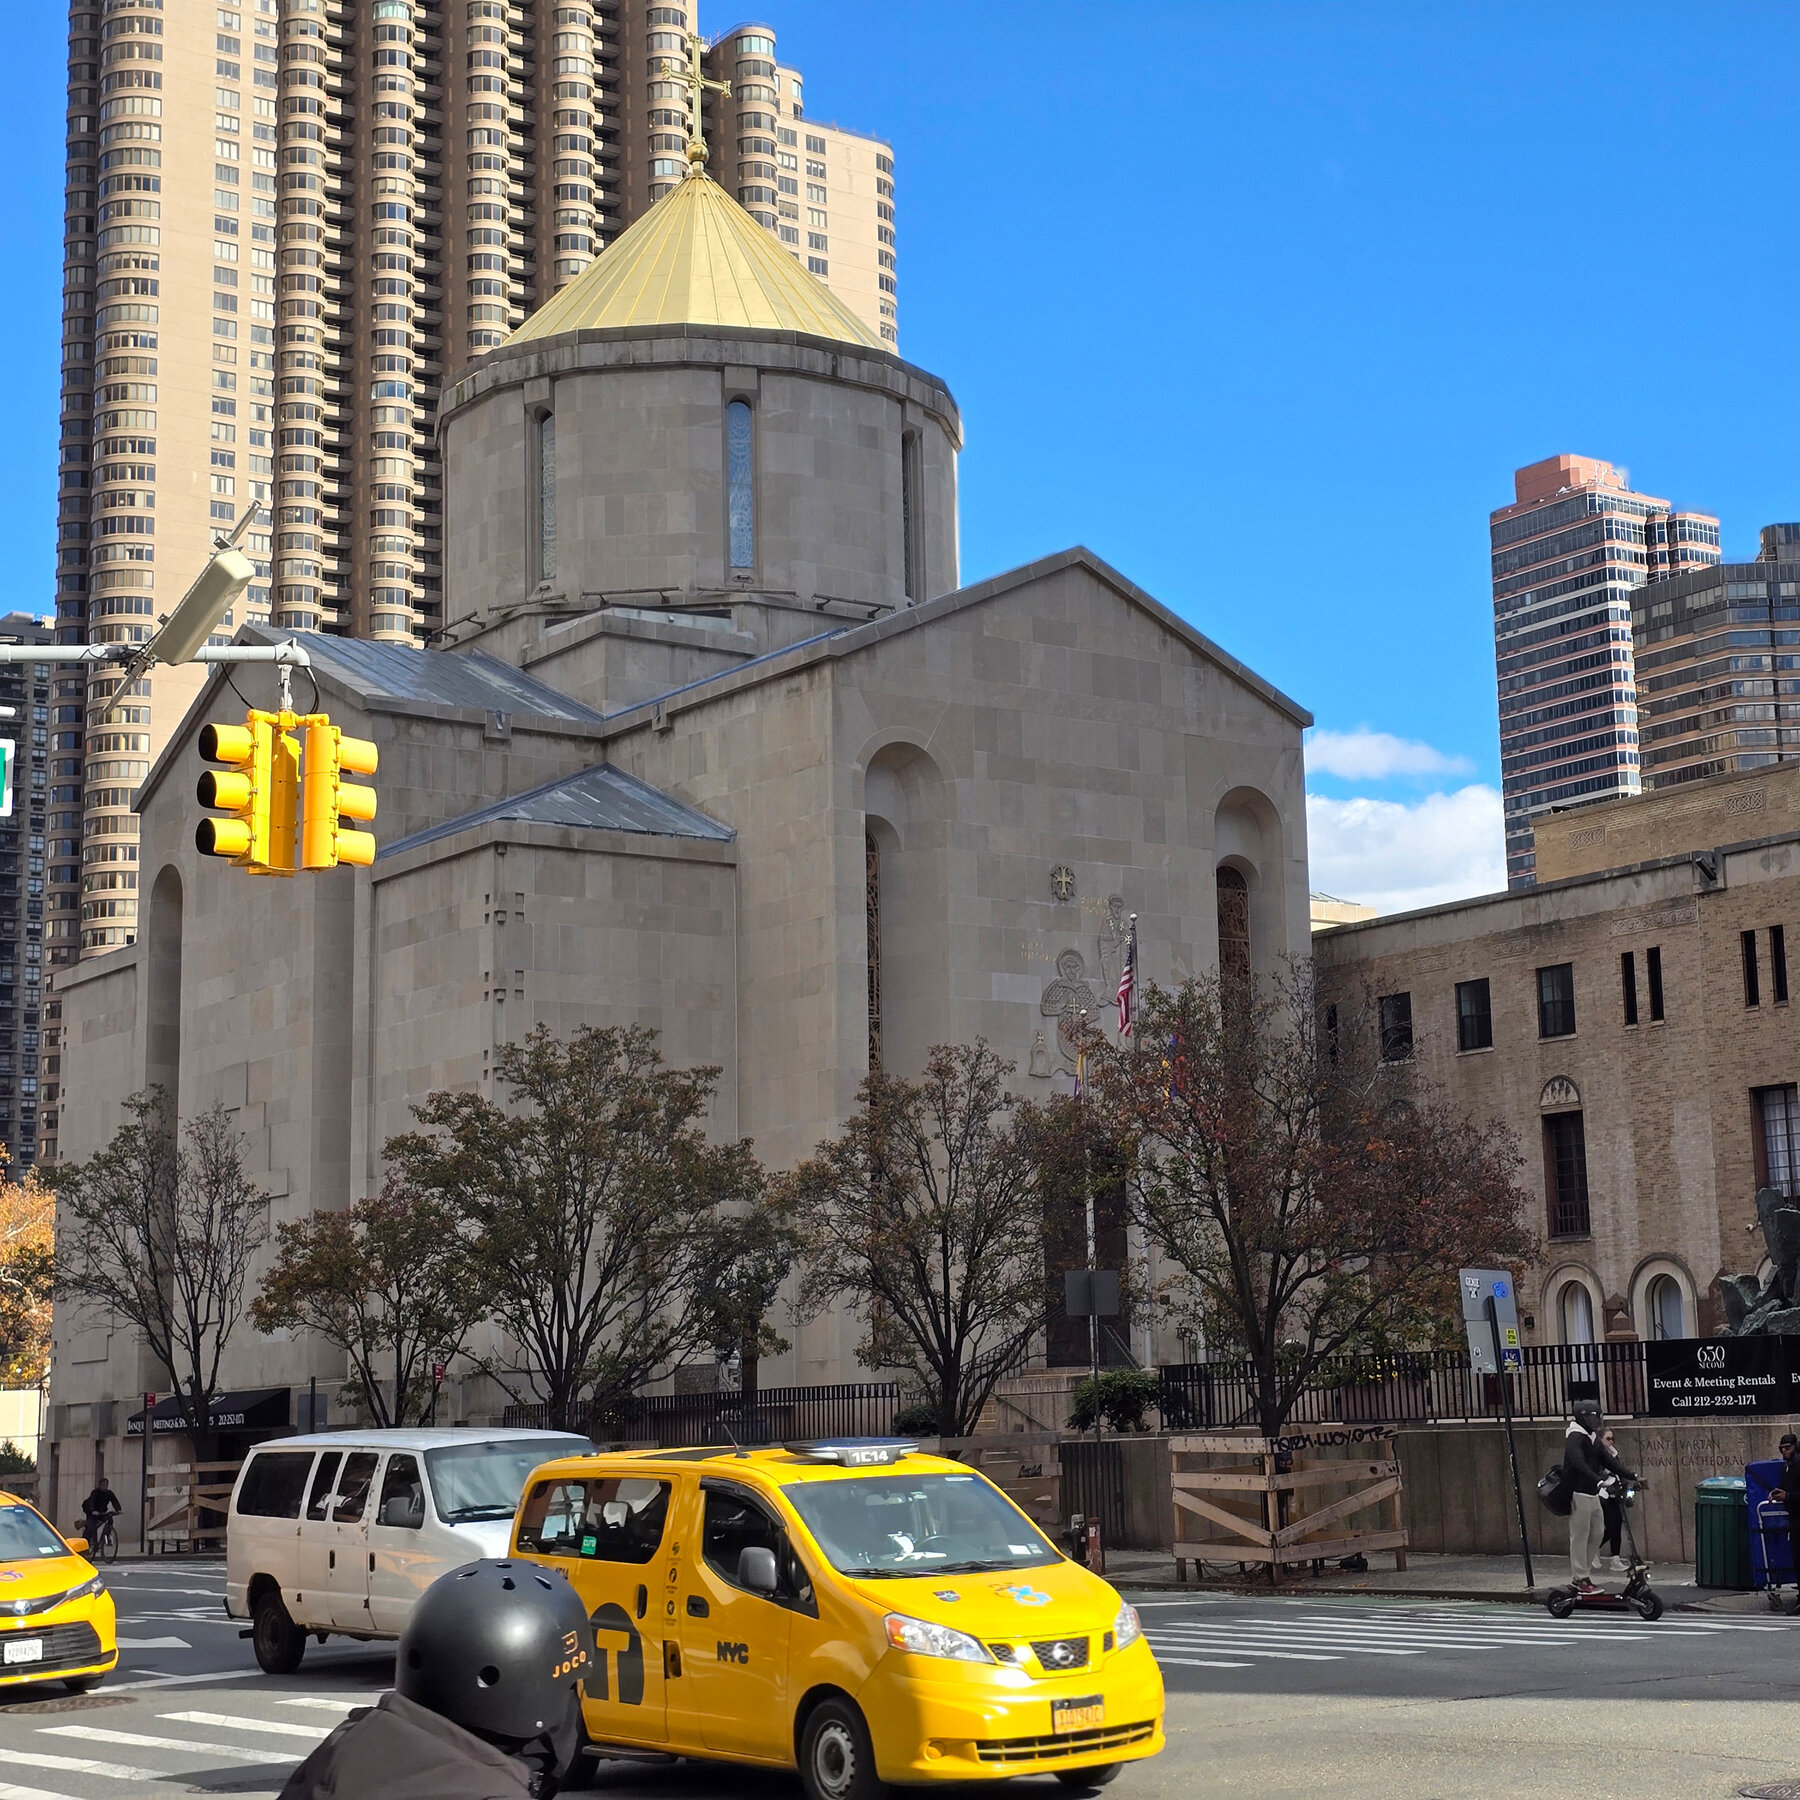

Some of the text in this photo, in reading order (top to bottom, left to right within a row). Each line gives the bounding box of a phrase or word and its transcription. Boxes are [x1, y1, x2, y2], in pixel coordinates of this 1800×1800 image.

[1653, 1374, 1776, 1389] Event & Meeting Rentals
[1671, 1395, 1757, 1407] Call 212-252-1171
[1639, 1439, 1721, 1451] SAINT VARTAN
[851, 1450, 889, 1463] 1C14
[1621, 1455, 1746, 1467] RMENIAN CATHEDRAL
[716, 1641, 749, 1664] NYC
[552, 1650, 586, 1678] JOCO
